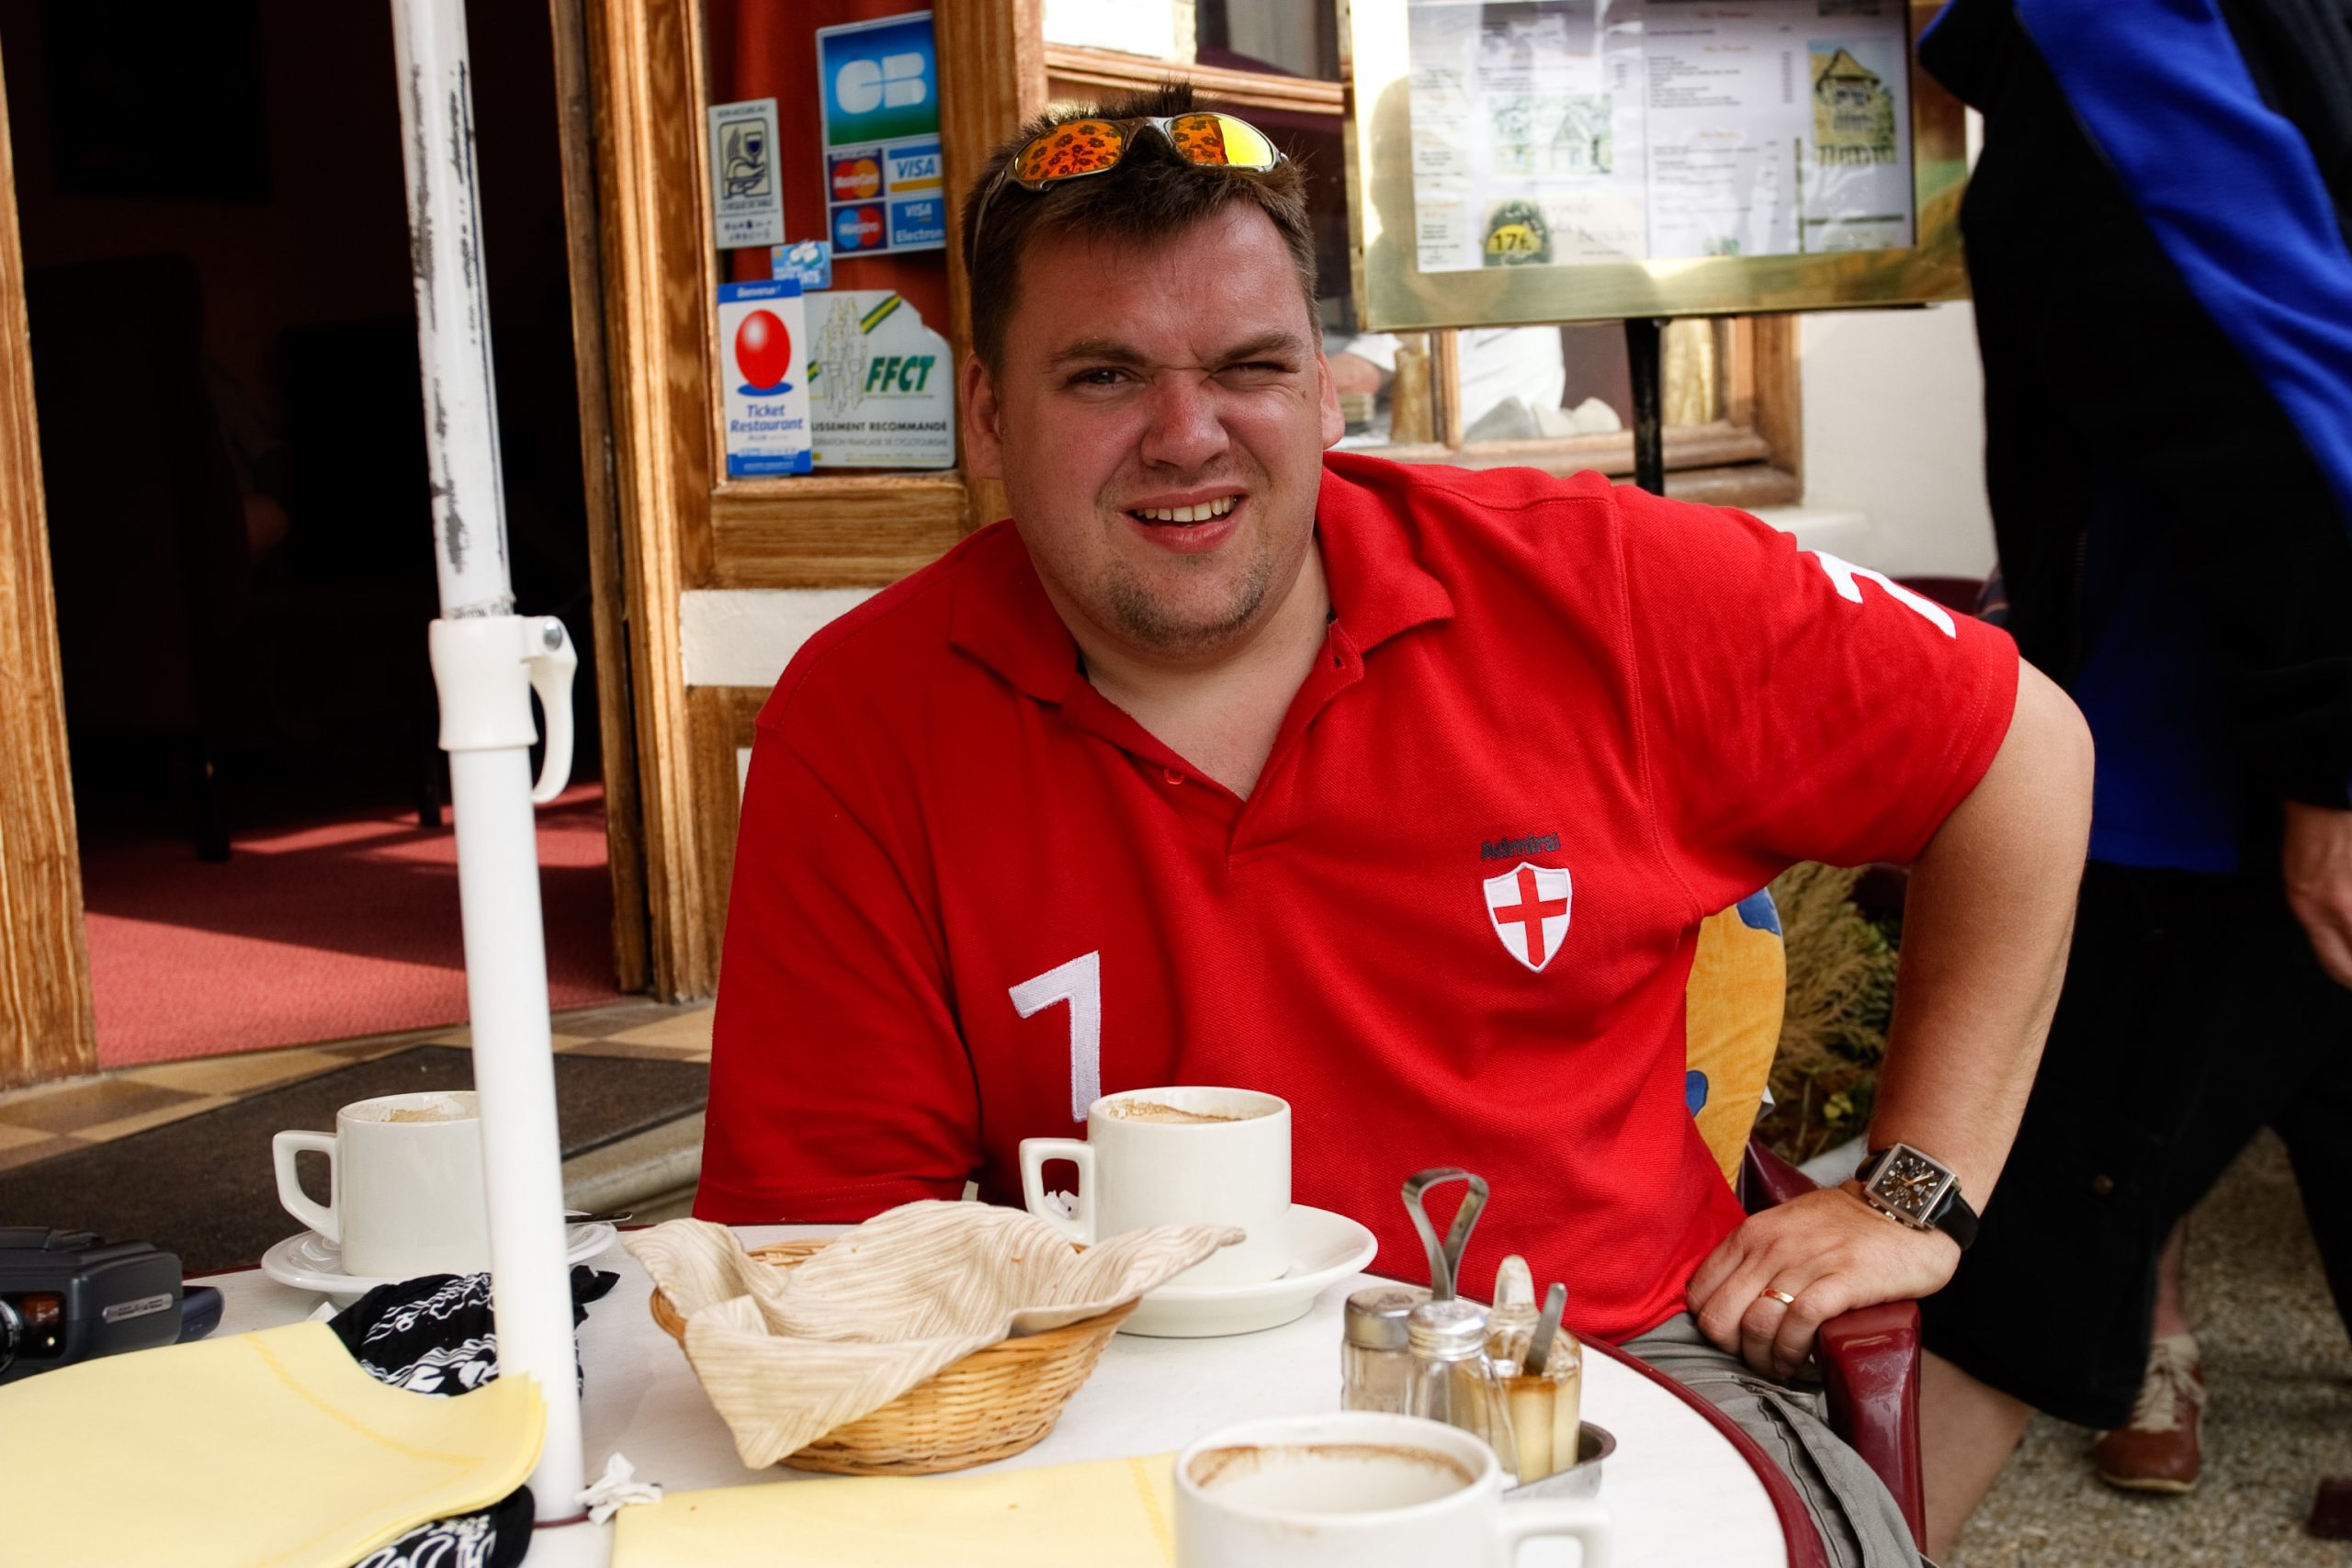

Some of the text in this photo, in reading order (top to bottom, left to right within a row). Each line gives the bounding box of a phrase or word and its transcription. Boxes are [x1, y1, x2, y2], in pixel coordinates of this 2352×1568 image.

[896, 157, 935, 178] VISA
[905, 203, 932, 217] VISA
[896, 229, 944, 244] Electron
[865, 355, 935, 392] FFCT
[746, 403, 785, 417] Ticket
[729, 418, 803, 434] Restaurant
[1480, 832, 1561, 861] Admiral
